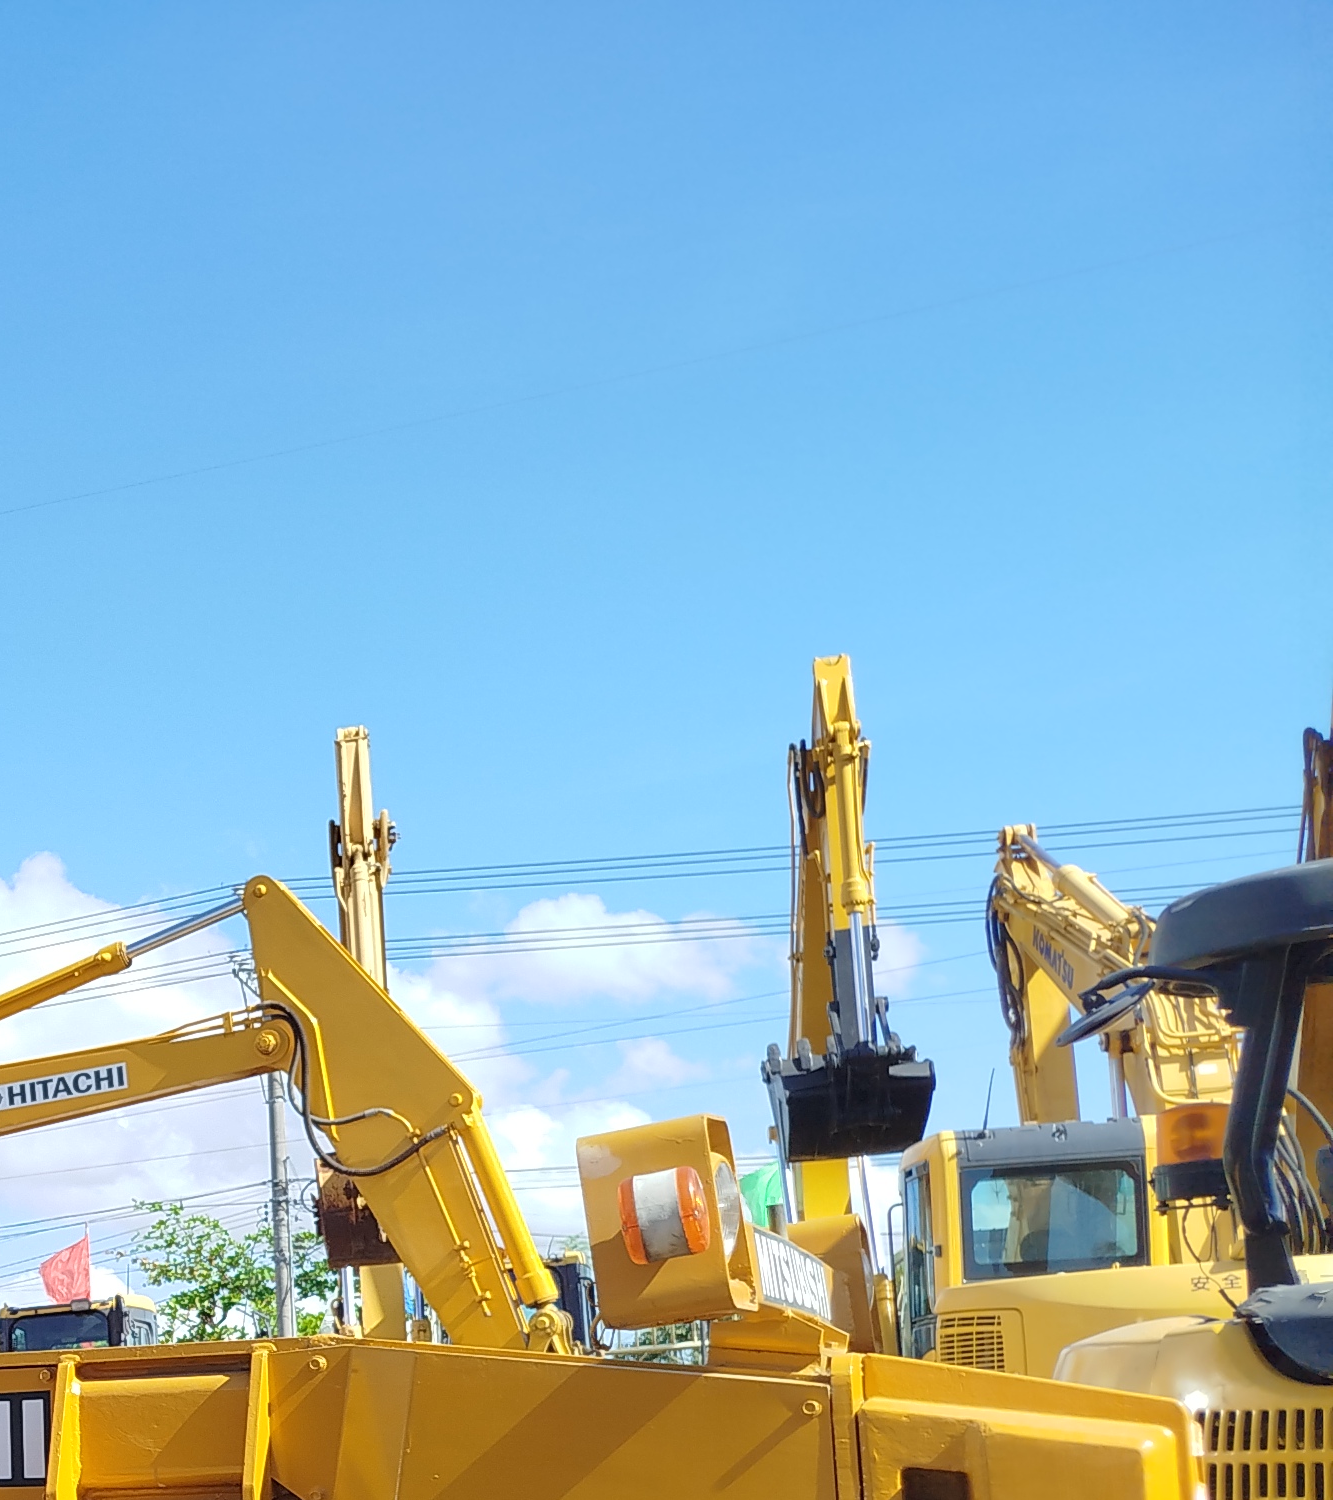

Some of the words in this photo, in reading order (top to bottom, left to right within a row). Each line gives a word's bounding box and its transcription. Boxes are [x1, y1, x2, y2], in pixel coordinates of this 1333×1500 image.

[1033, 924, 1074, 990] KOMATSU
[7, 1065, 125, 1106] HITACHI
[754, 1232, 832, 1321] MITSUBISHI
